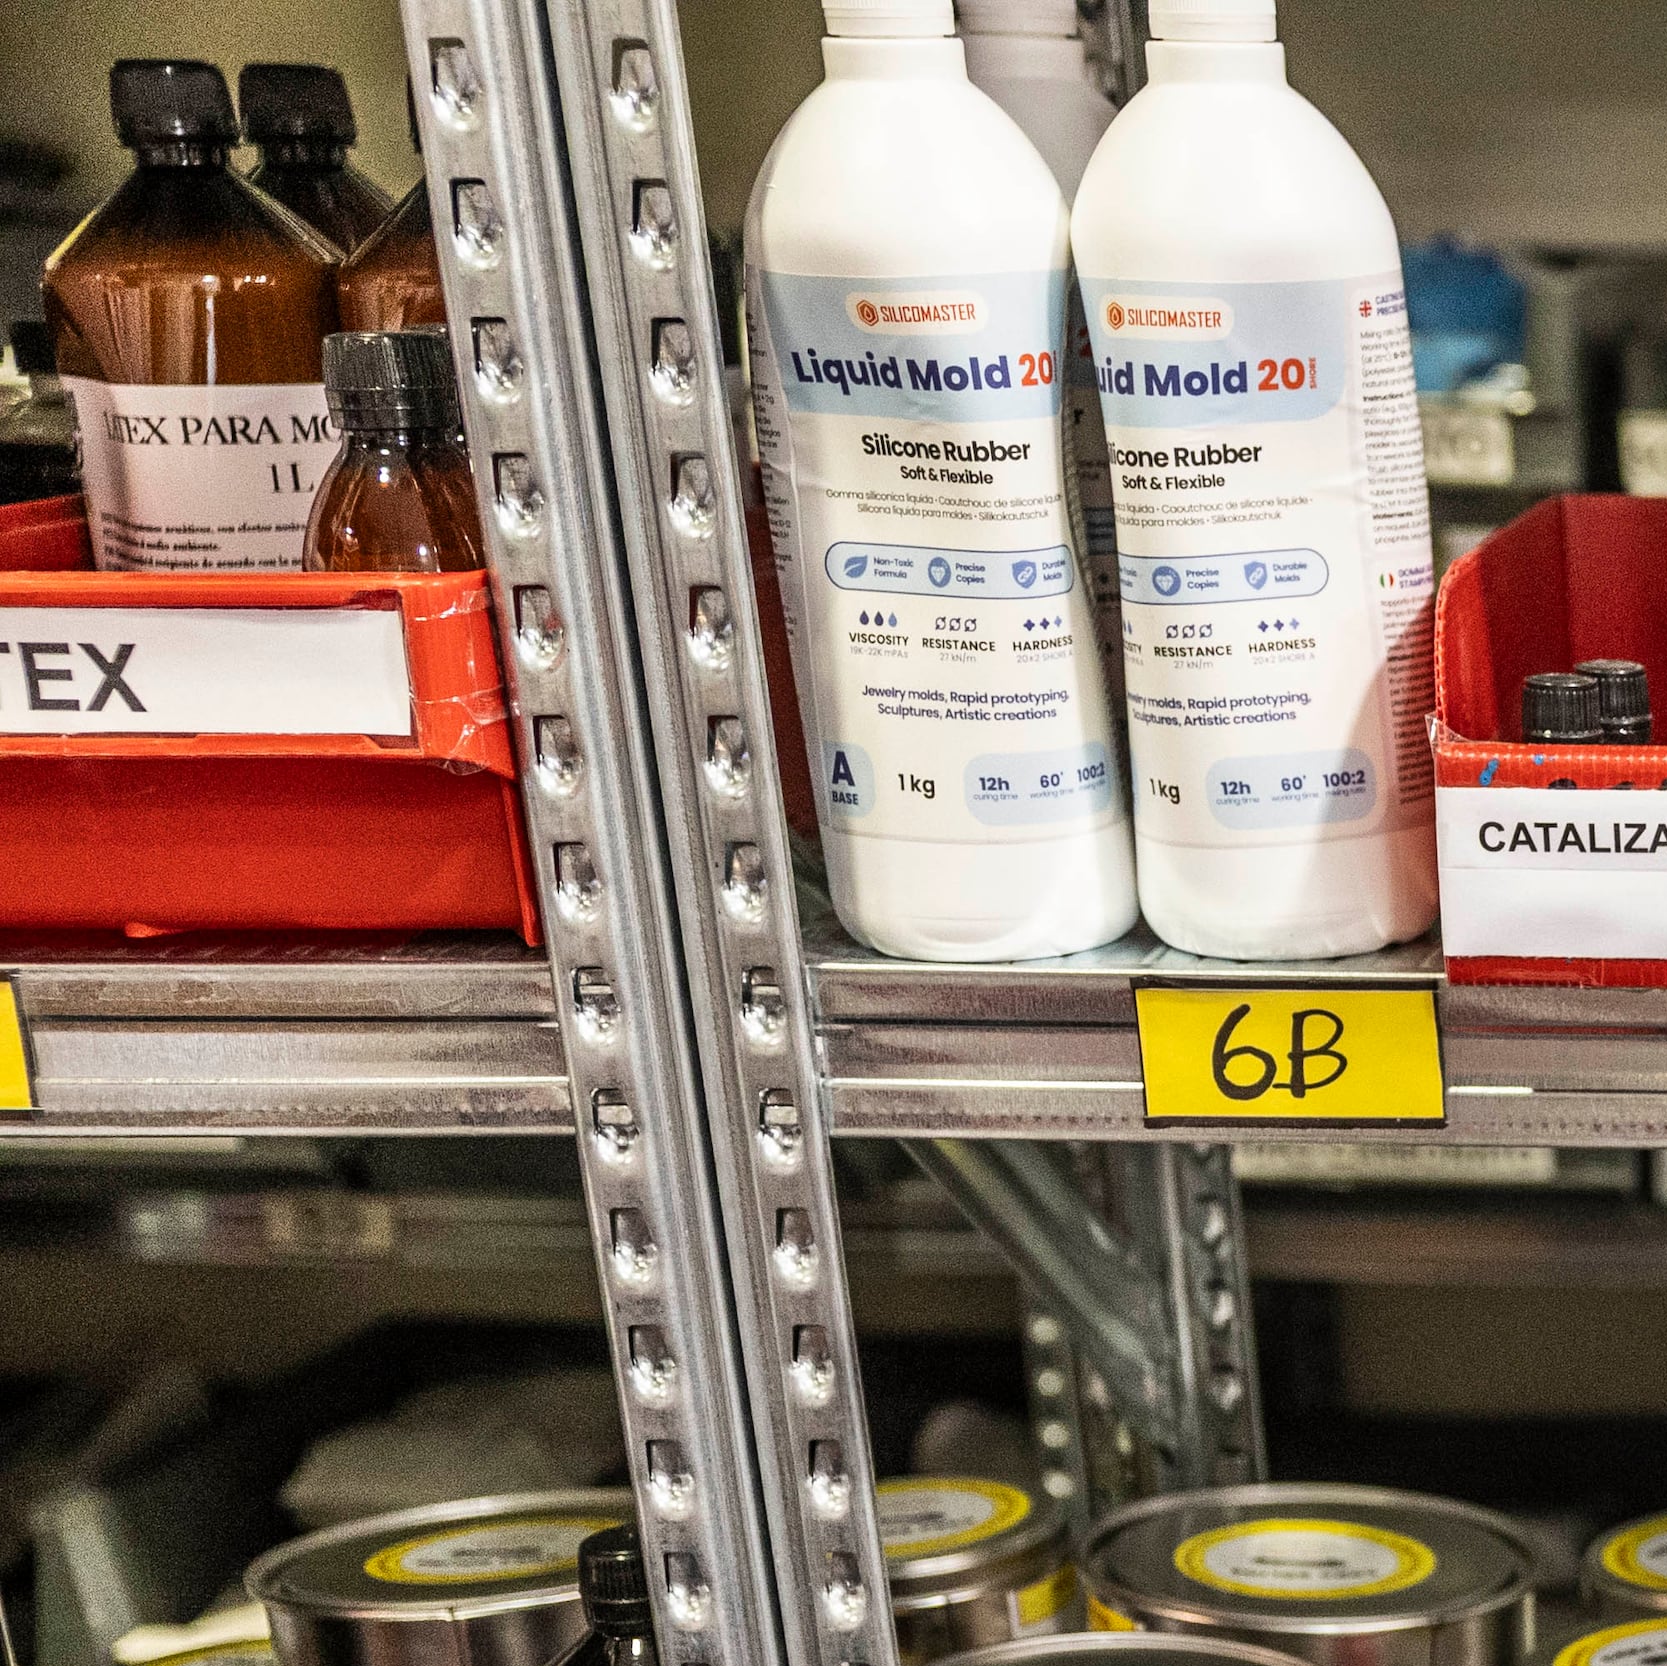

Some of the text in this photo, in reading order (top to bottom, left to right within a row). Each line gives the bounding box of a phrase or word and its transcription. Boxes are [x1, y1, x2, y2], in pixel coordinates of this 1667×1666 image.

[880, 302, 977, 324] SILICOMASTER
[1127, 308, 1223, 329] SILICOMASTER
[790, 347, 1055, 396] Liquid Mold 20
[1144, 358, 1305, 397] Mold 20
[181, 415, 281, 445] PARA
[861, 433, 1032, 463] Silicone Rubber
[1174, 443, 1263, 467] Rubber
[291, 462, 315, 493] L
[900, 465, 928, 482] Soft
[940, 468, 994, 486] Flexible
[1122, 474, 1148, 490] Soft
[1166, 474, 1225, 491] Flexible
[874, 568, 908, 580] Formula
[955, 562, 986, 573] Precise
[1186, 568, 1219, 579] Precise
[955, 573, 985, 586] Copies
[1187, 579, 1219, 591] Copies
[848, 632, 909, 647] VISCOSITY
[922, 637, 996, 652] RESISTANCE
[1012, 635, 1073, 652] HARDNESS
[1248, 638, 1316, 654] HARDNESS
[1154, 645, 1233, 658] RESISTANCE
[861, 685, 988, 706] Jewelry molds, Rapid
[1187, 696, 1227, 712] Rapid
[878, 703, 1057, 722] Sculptures, Artistic creations
[1184, 709, 1297, 727] Artistic creations
[831, 750, 856, 788] A
[898, 774, 936, 799] 1 kg
[979, 776, 1010, 792] 12h
[1323, 770, 1366, 788] 100:2
[1158, 780, 1180, 805] kg
[1220, 781, 1251, 796] 12h
[832, 791, 859, 806] BASE
[1211, 1003, 1348, 1101] 6B
